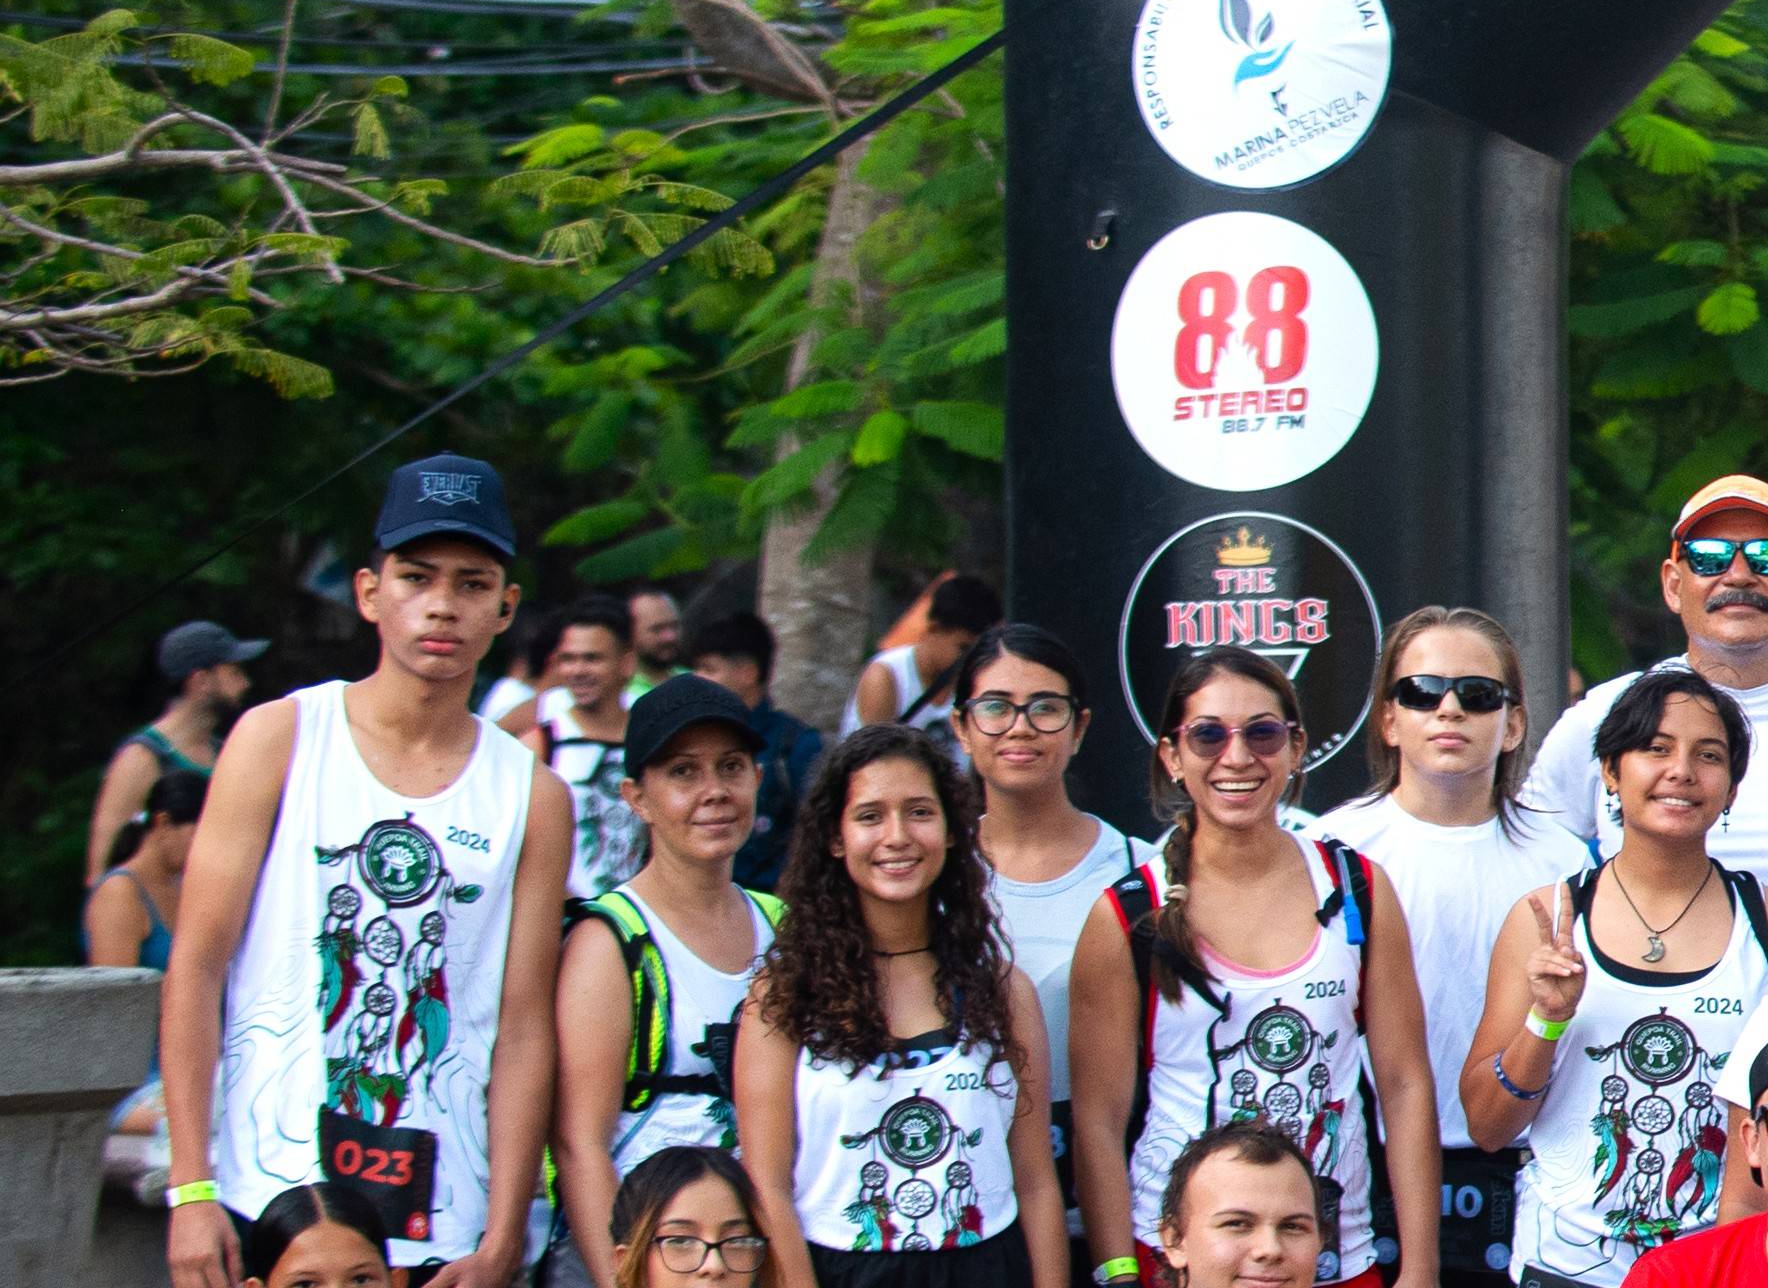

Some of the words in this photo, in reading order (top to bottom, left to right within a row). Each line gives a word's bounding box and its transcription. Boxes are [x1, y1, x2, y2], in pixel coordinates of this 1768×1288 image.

[1213, 126, 1289, 170] MARINA
[1173, 265, 1312, 391] 88
[1173, 387, 1309, 422] STEREO
[1222, 417, 1266, 435] 88.7
[1275, 414, 1306, 430] FM
[1211, 567, 1277, 596] THE
[1163, 597, 1332, 649] KINGS
[446, 824, 491, 854] 2024
[1305, 978, 1346, 1000] 2024
[1693, 996, 1744, 1016] 2024
[332, 1138, 416, 1187] 023
